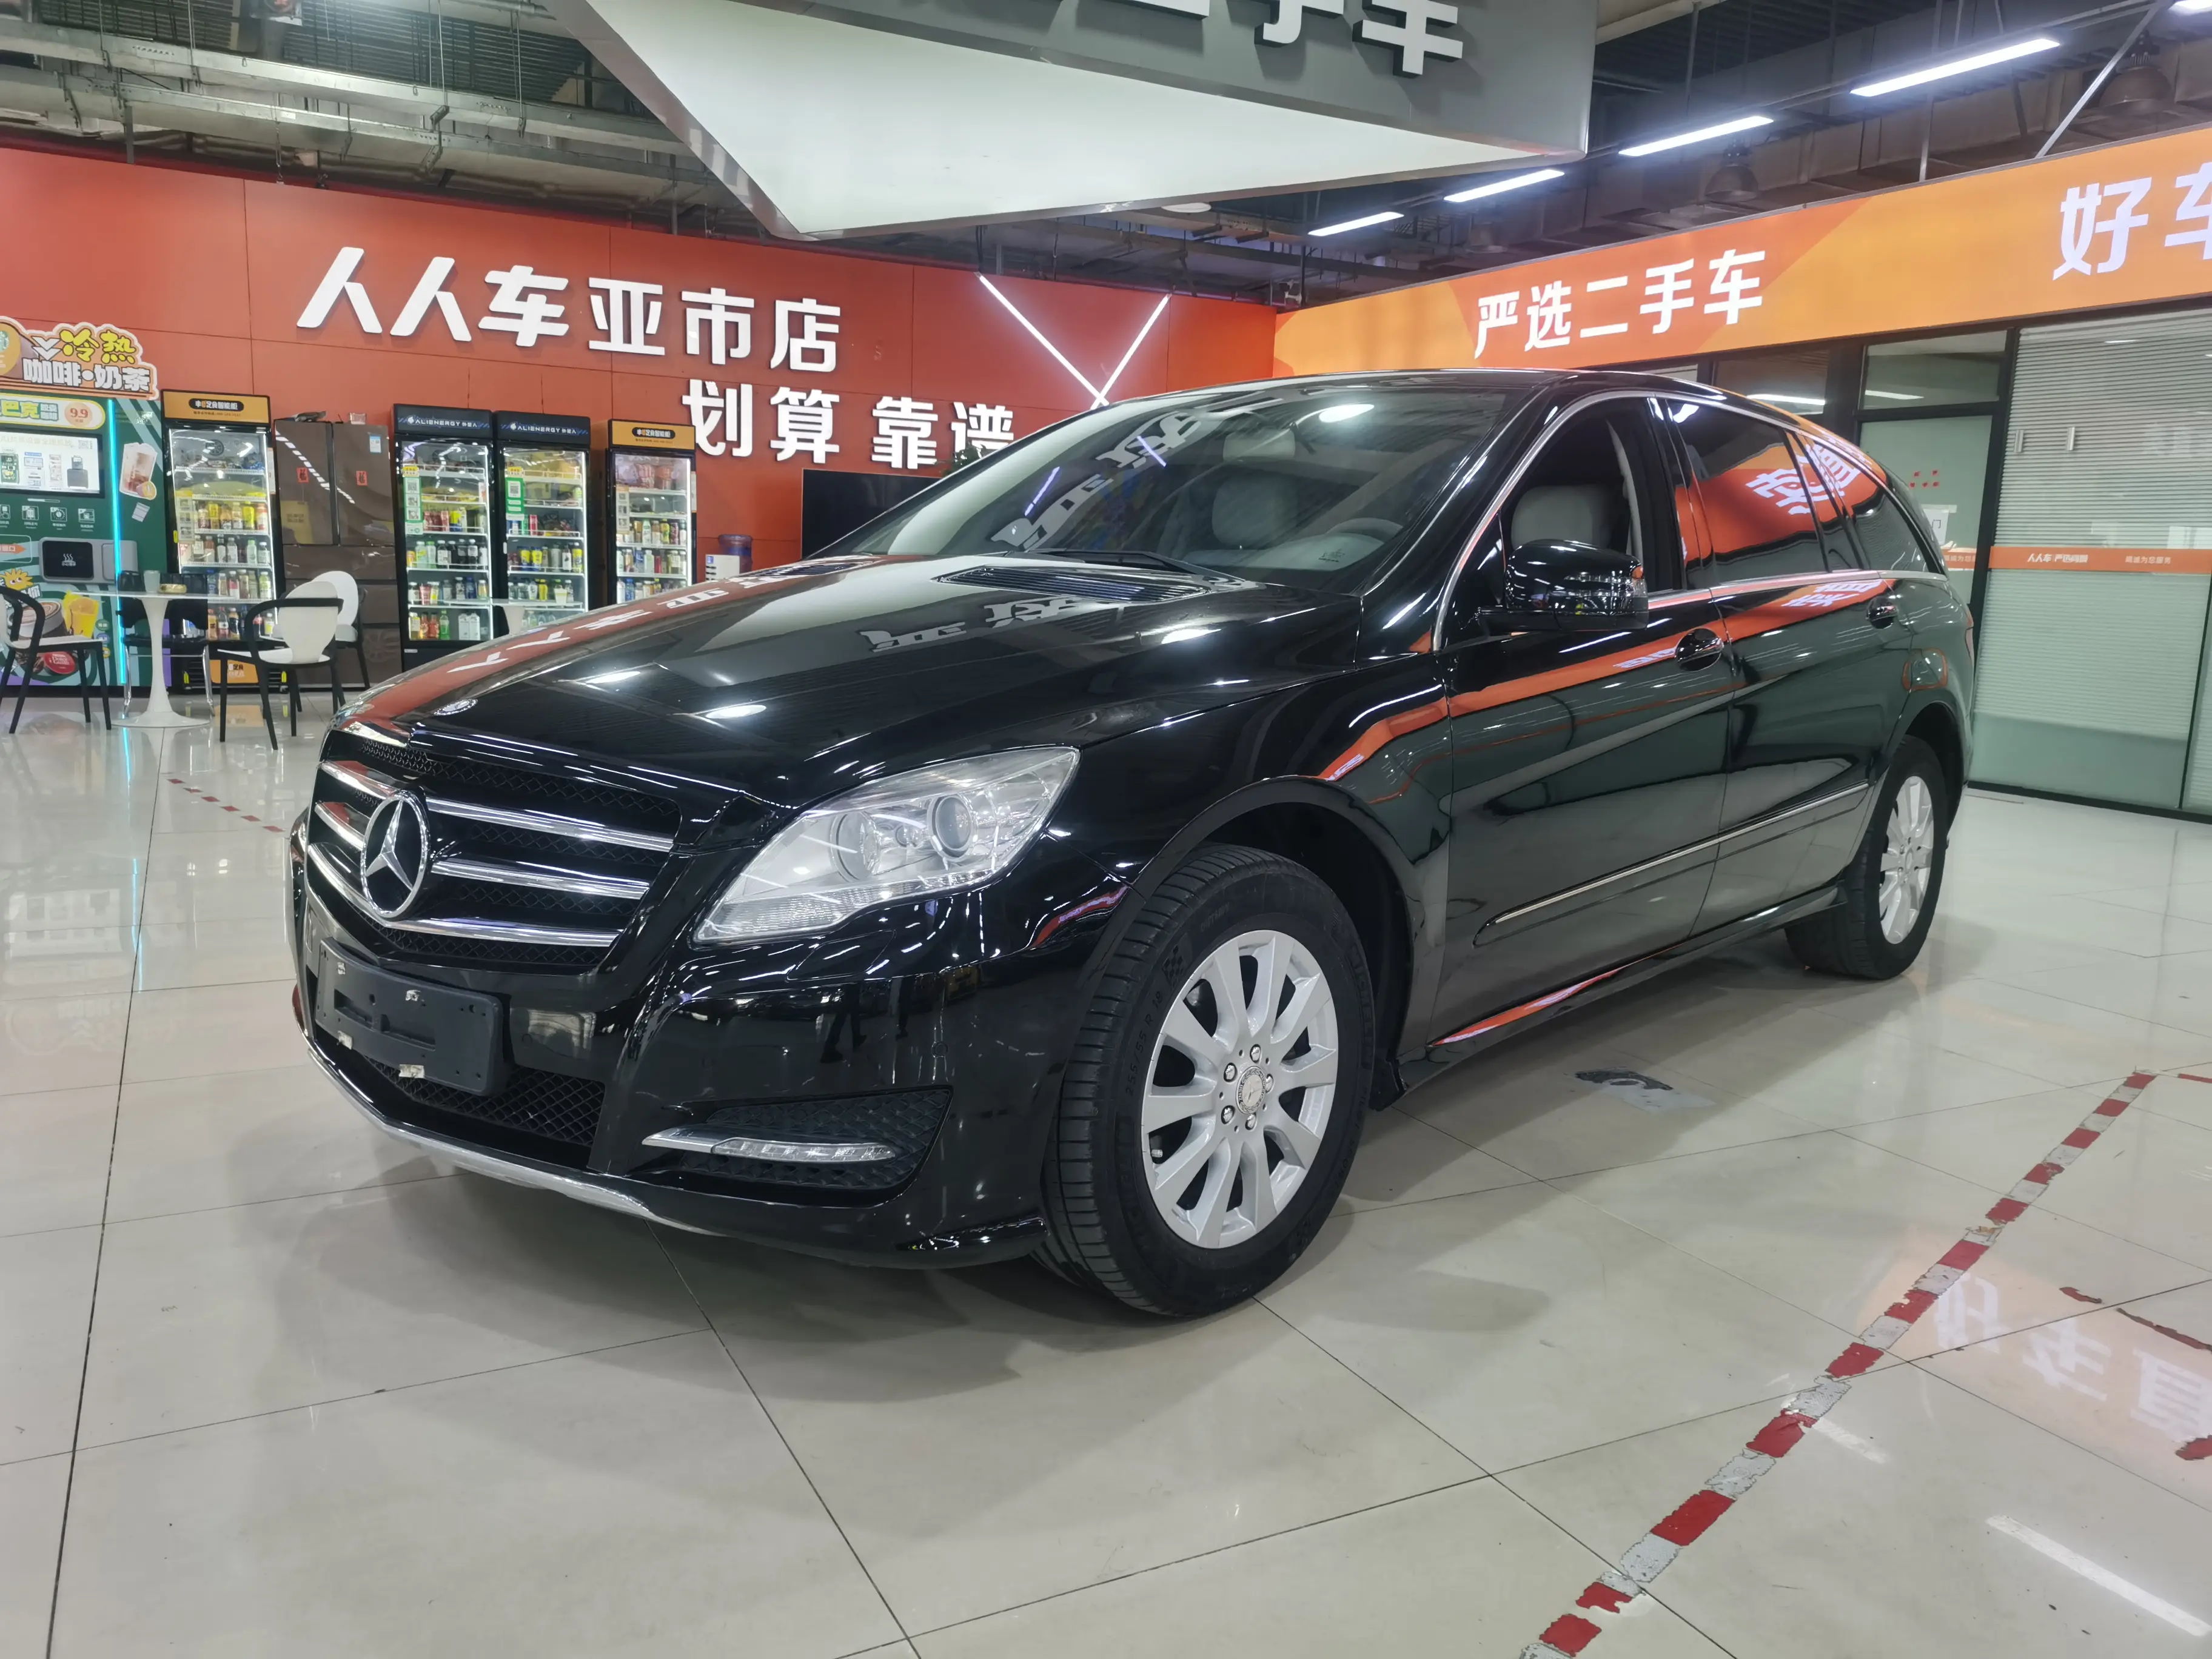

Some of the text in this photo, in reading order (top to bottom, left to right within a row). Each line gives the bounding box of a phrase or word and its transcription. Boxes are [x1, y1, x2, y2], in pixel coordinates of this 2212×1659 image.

[59, 328, 136, 364] 冷热
[297, 246, 841, 373] 人人车亚市店
[1474, 249, 1766, 360] 严选二手车
[0, 399, 40, 419] 巴克
[682, 378, 1014, 470] 划算 靠谱
[2027, 553, 2053, 563] 人人车
[1125, 1031, 1147, 1097] 255/55
[1144, 1013, 1153, 1027] R
